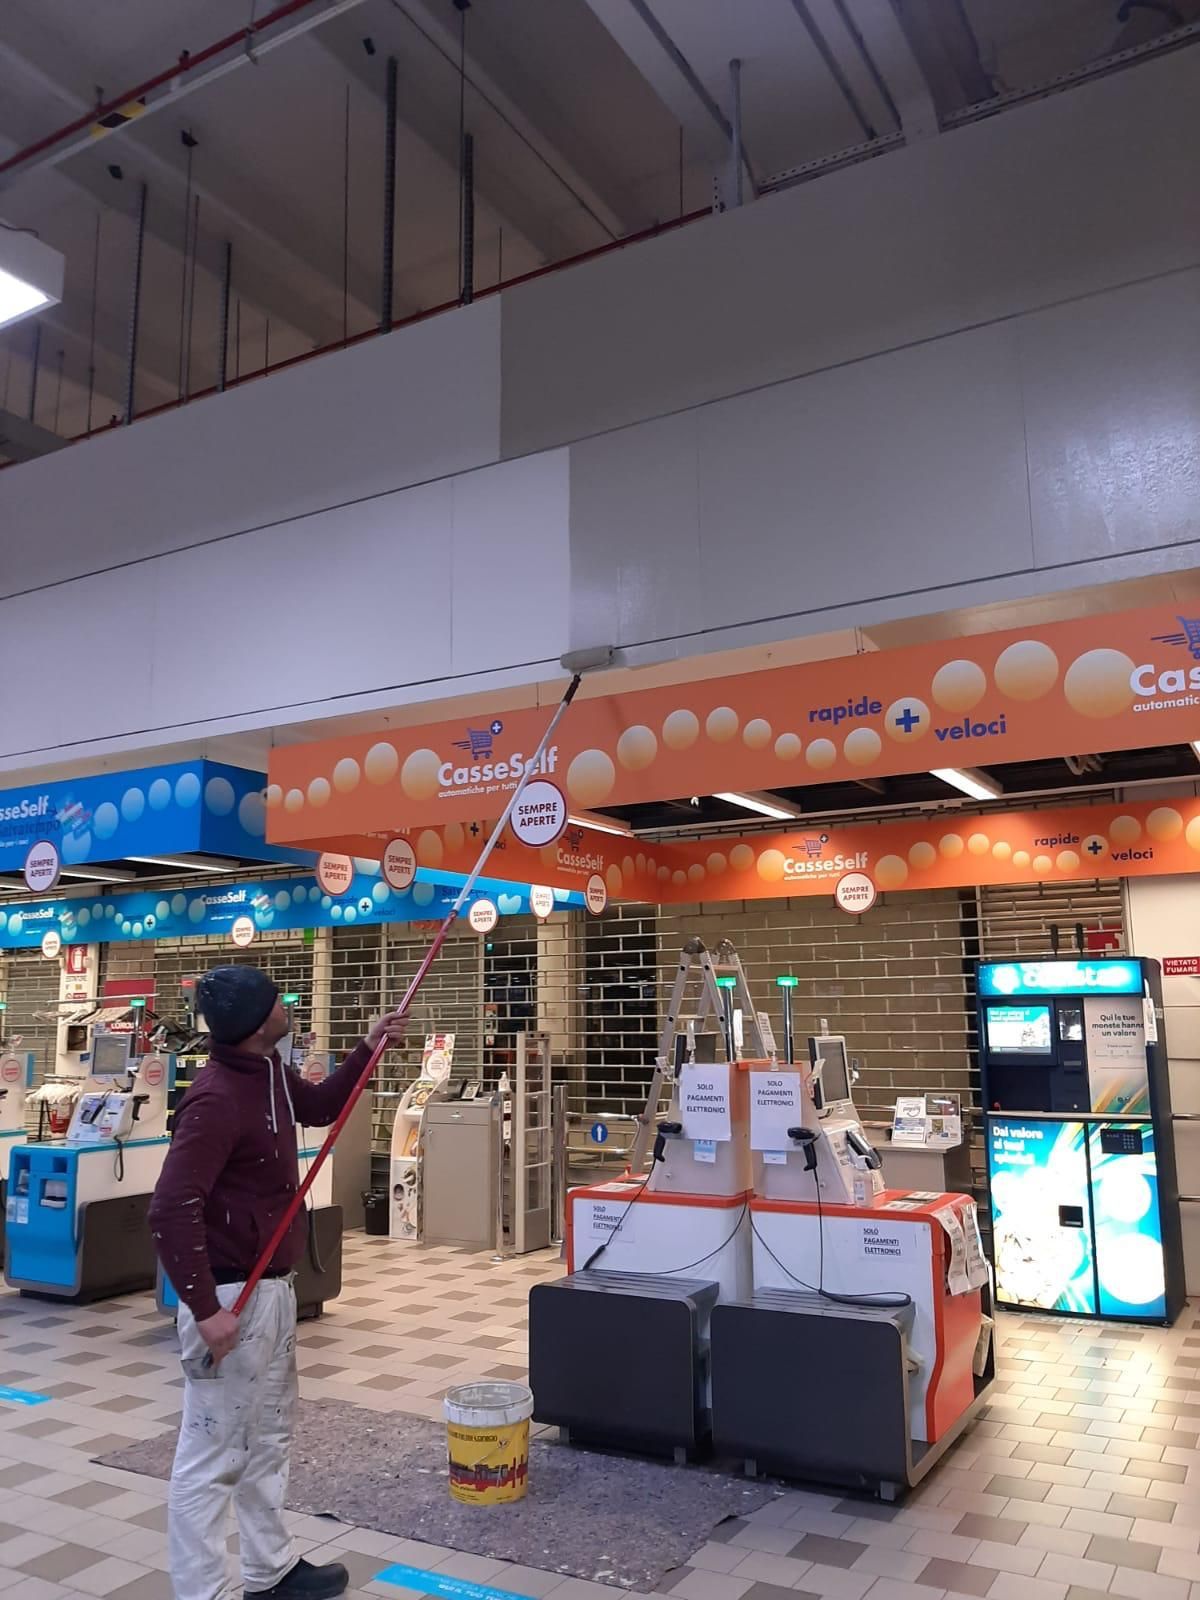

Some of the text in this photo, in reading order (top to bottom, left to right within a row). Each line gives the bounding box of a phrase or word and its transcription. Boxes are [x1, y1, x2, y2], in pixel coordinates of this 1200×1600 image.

[808, 696, 882, 725] rapide
[934, 714, 1007, 742] veloci
[438, 746, 558, 786] CasseSelf
[438, 785, 484, 798] automatiche
[486, 785, 499, 794] per
[518, 802, 558, 815] SEMPRE
[519, 815, 557, 827] APERTE
[1034, 833, 1080, 848] rapide
[1111, 848, 1153, 861] veloci
[30, 858, 55, 868] SEMPRE
[388, 855, 412, 866] SEMPRE
[556, 848, 604, 872] CasseSelf
[783, 851, 868, 874] CasseSelf
[323, 861, 349, 872] SEMPRE
[389, 865, 411, 875] APERTE
[30, 868, 53, 877] APERTE
[324, 872, 347, 881] APERTE
[841, 885, 869, 894] SEMPRE
[842, 893, 869, 901] APERTE
[1100, 1014, 1114, 1022] Qui
[1112, 1029, 1137, 1037] valore
[687, 1094, 724, 1102] PAGAMENTI
[758, 1089, 793, 1097] PAGAMENTI
[757, 1099, 794, 1107] ELETTRONICI
[686, 1105, 726, 1114] ELETTRONICI
[992, 1126, 1044, 1140] Dai valore
[863, 1227, 879, 1236] SOLO
[864, 1237, 899, 1247] PAGAMENTI
[864, 1246, 901, 1256] ELETTRONICI
